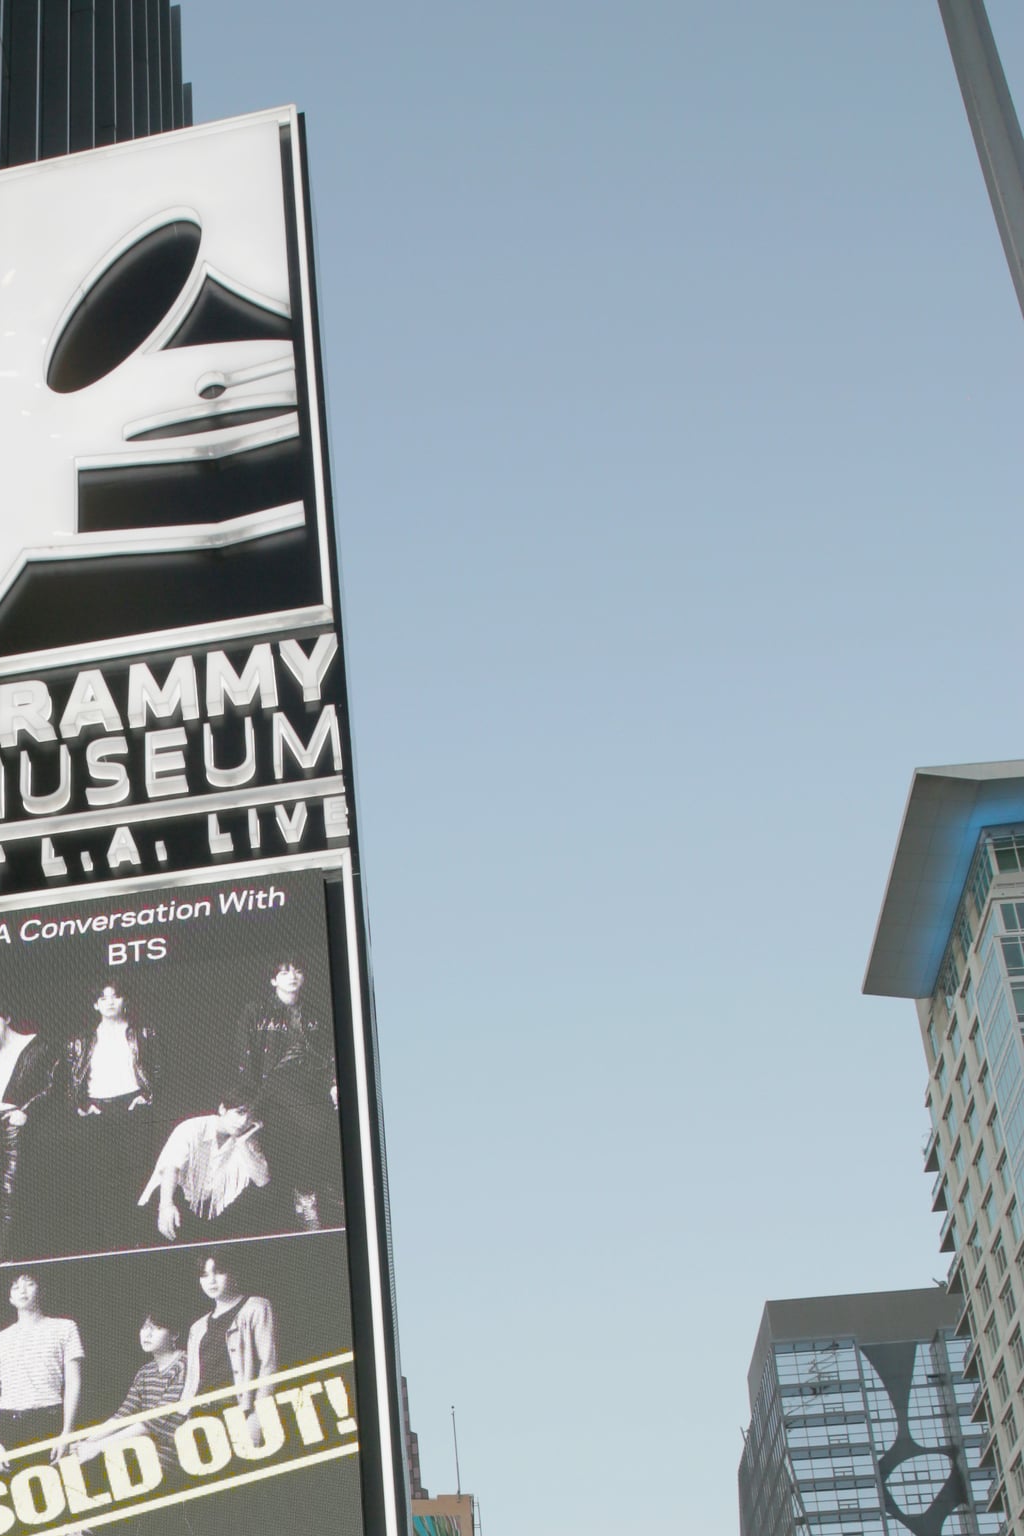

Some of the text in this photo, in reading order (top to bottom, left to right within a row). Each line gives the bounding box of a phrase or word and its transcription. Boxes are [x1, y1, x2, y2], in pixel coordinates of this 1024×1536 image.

[41, 826, 168, 877] L.A.
[207, 795, 350, 854] LIVE
[19, 899, 212, 943] Conversation
[218, 887, 285, 916] With
[107, 937, 167, 966] BTS
[174, 1376, 357, 1478] OUT!
